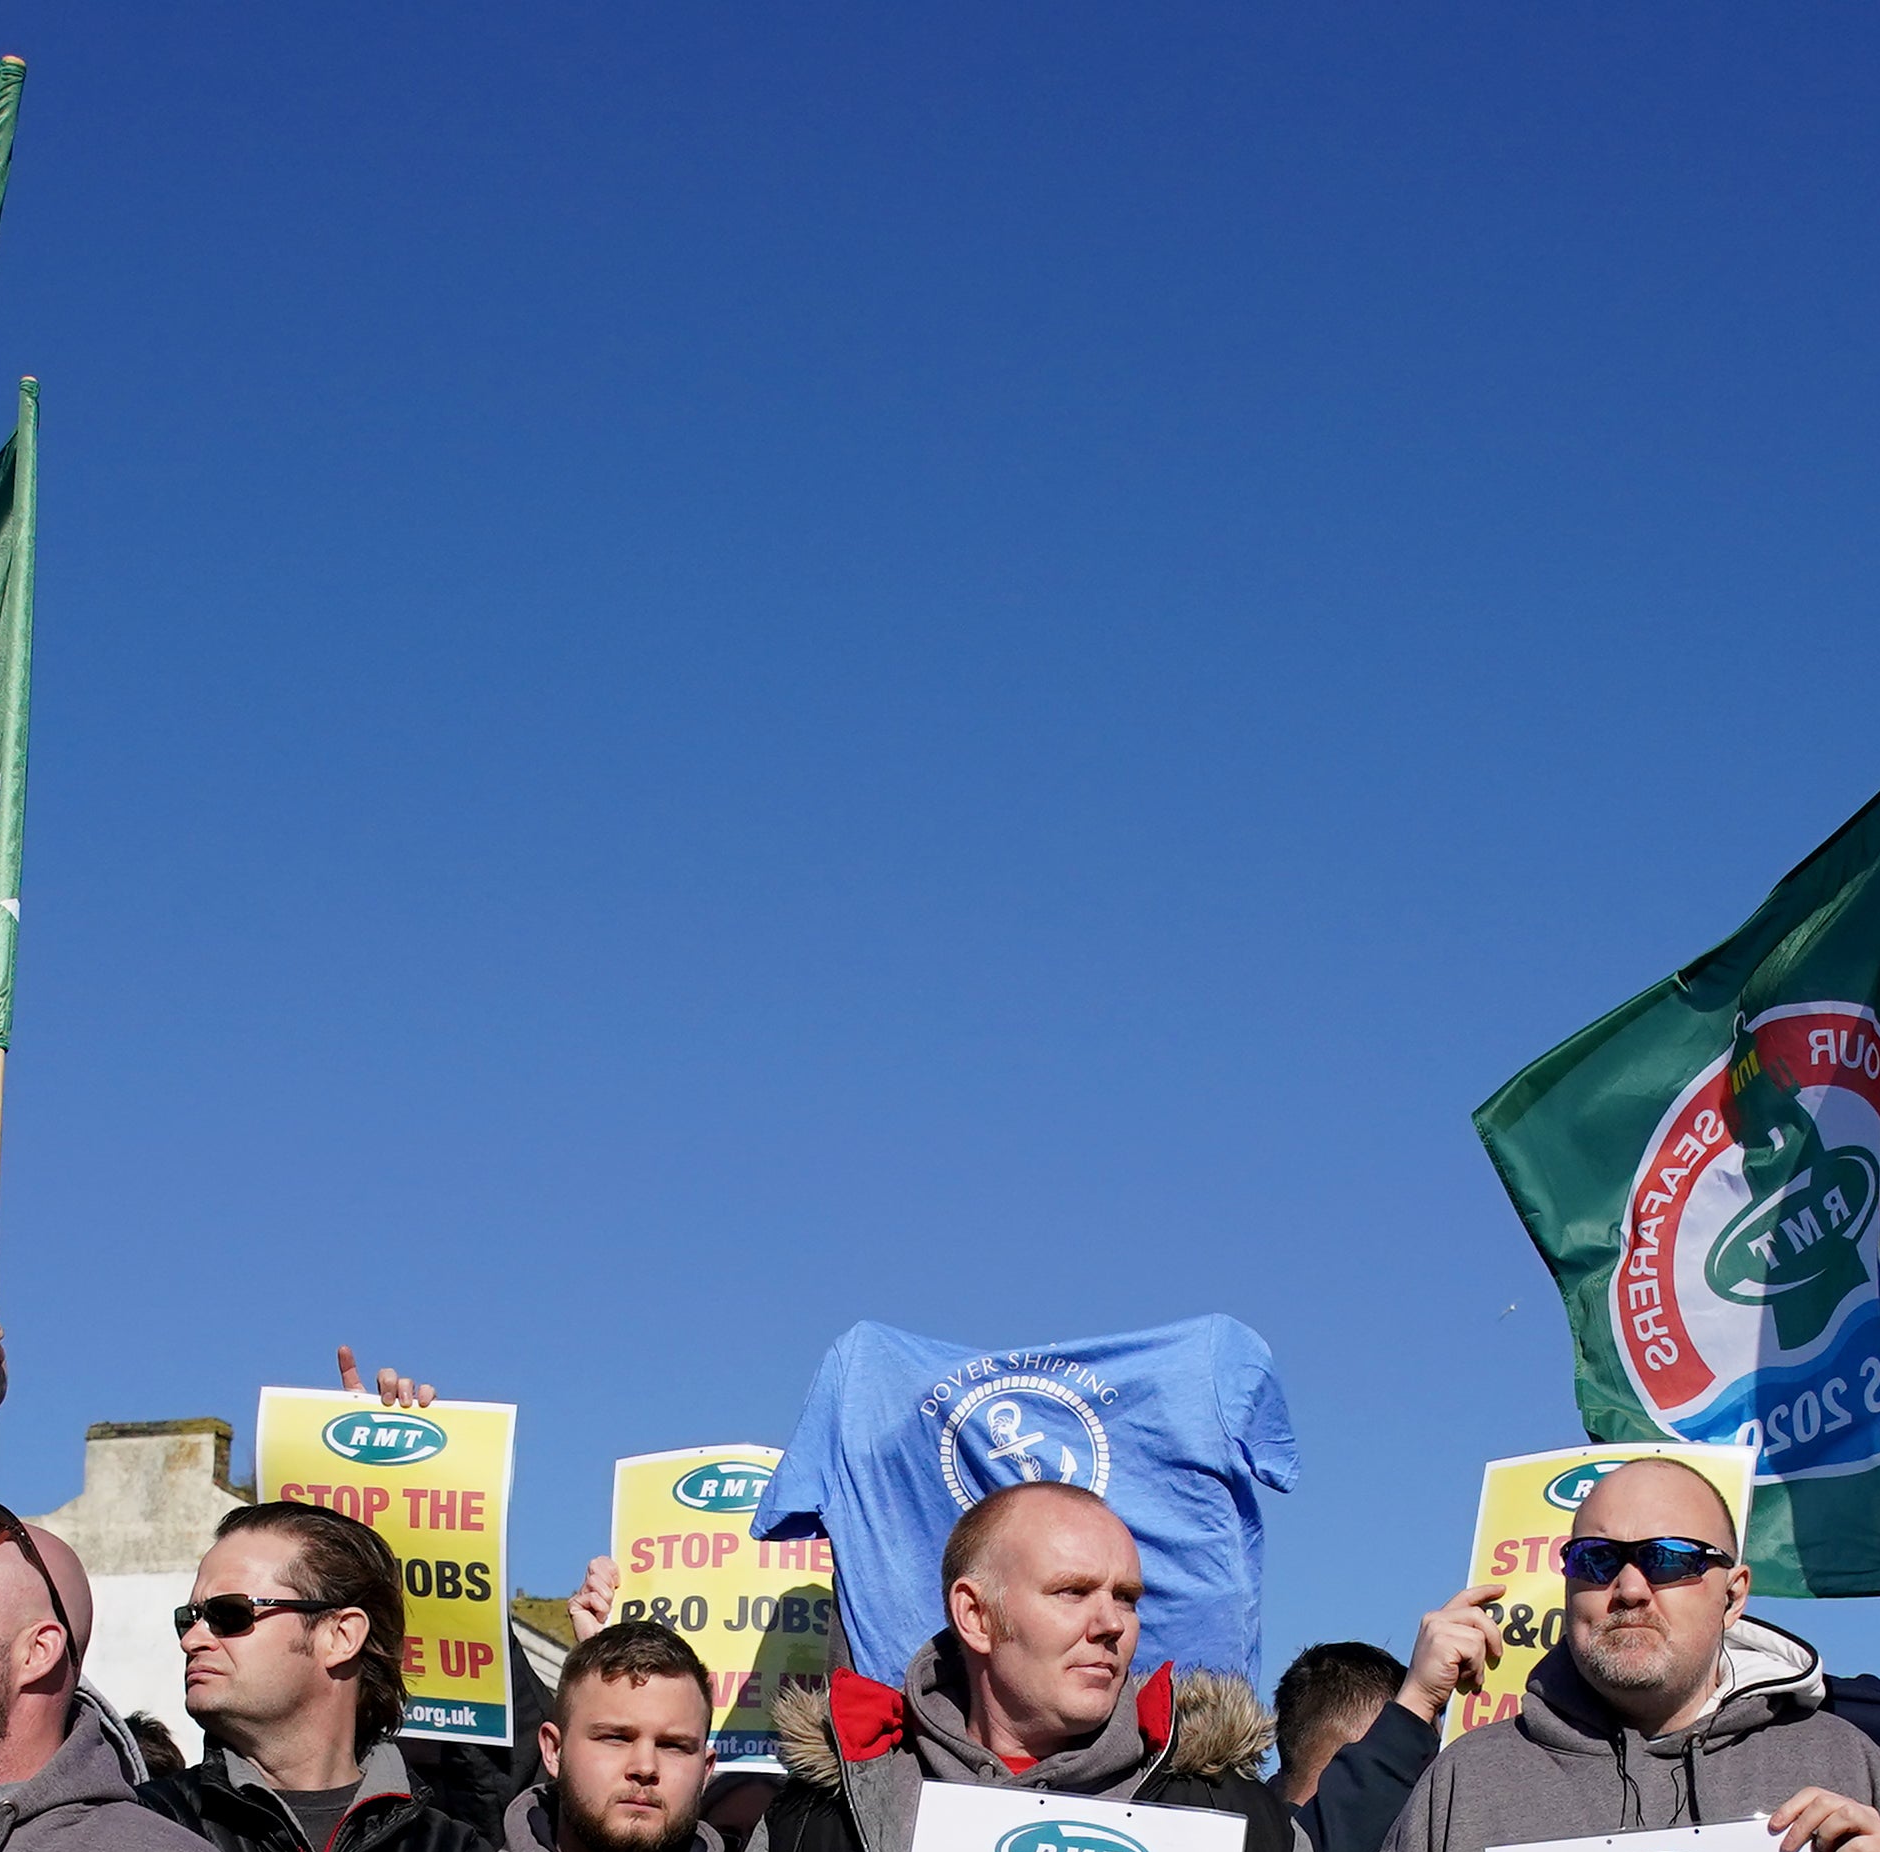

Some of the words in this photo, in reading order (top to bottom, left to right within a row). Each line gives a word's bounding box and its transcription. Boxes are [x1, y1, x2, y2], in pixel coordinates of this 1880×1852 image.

[920, 1356, 999, 1417] DOVER
[1008, 1352, 1119, 1406] SHIPPING
[349, 1426, 424, 1449] RMT
[698, 1478, 769, 1498] RMT
[402, 1488, 485, 1532] THE
[630, 1532, 739, 1574] STOP
[396, 1559, 492, 1602] OBS
[620, 1595, 708, 1632] P&O
[723, 1595, 829, 1636] JOBS
[440, 1639, 494, 1680] UP
